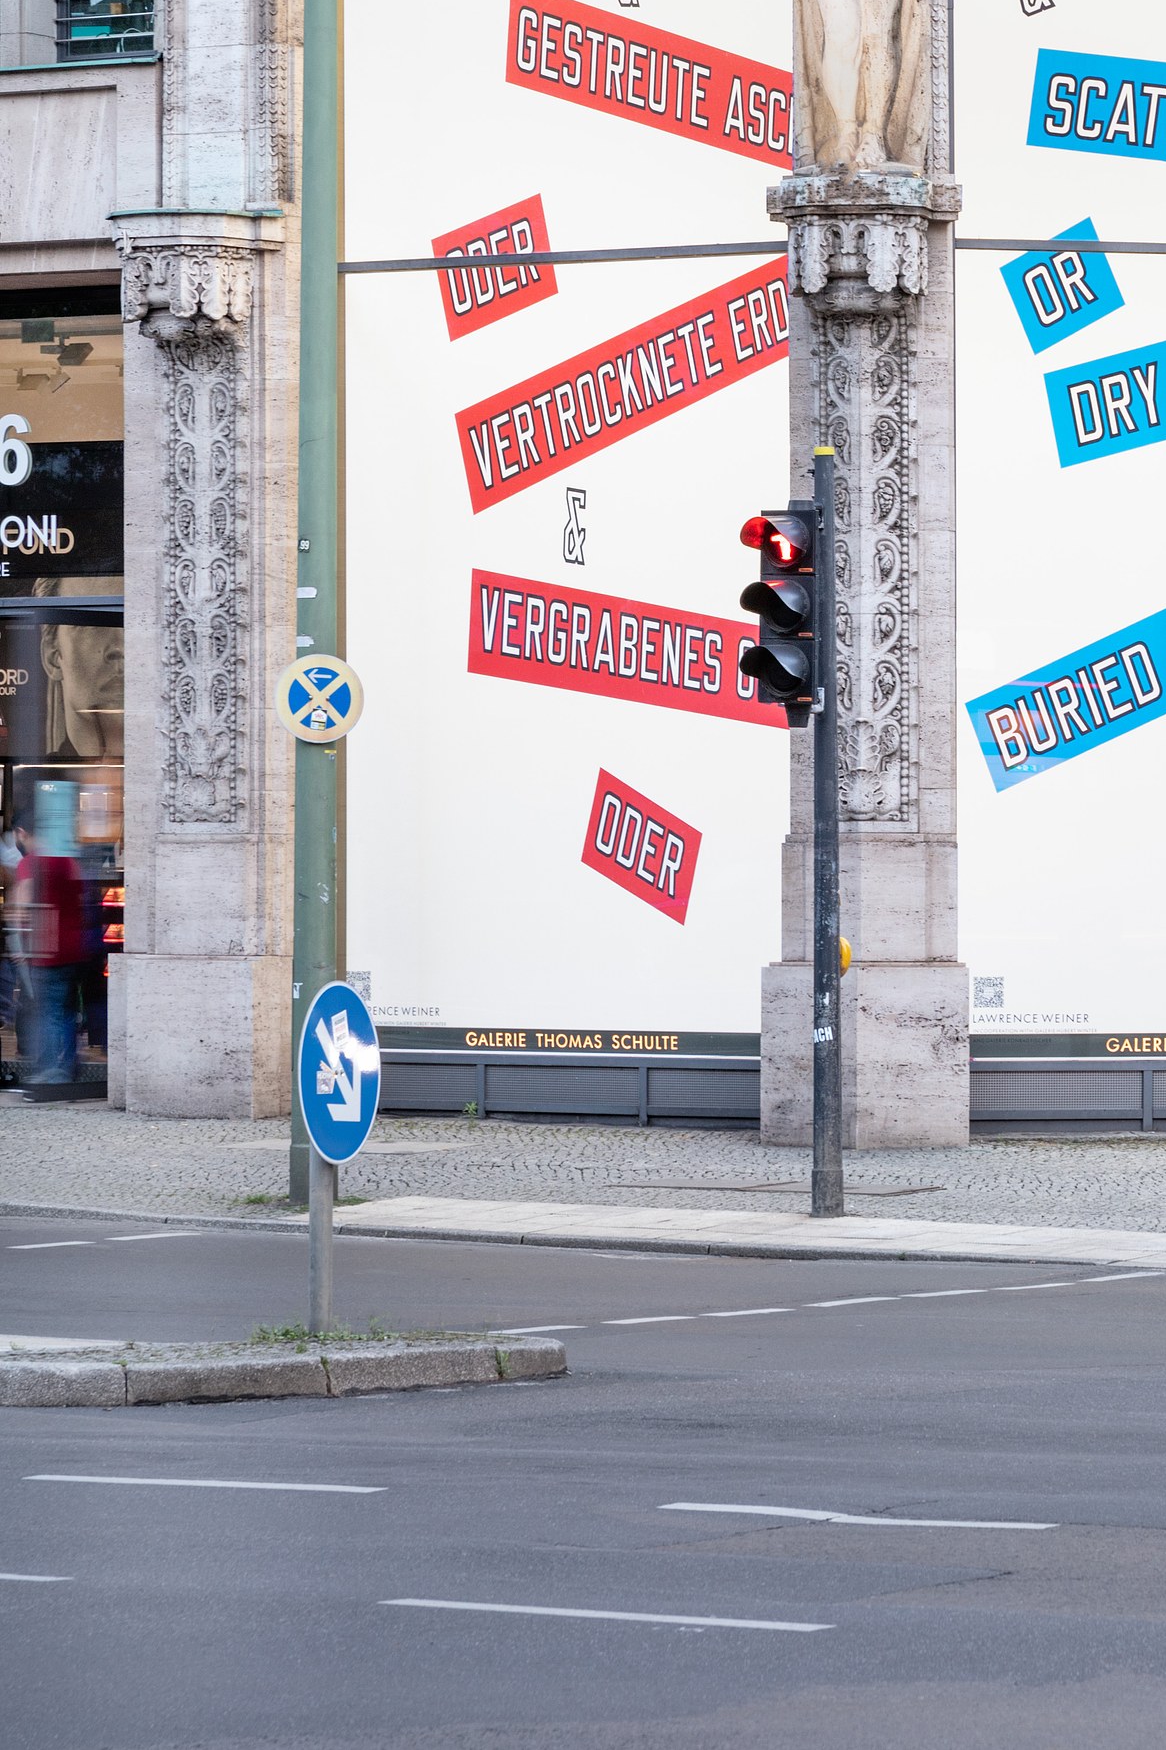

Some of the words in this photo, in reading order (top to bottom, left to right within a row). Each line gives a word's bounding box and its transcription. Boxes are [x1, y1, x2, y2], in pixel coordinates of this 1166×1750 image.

[516, 5, 711, 130] GESTREUTE
[445, 217, 541, 316] ODER
[1022, 249, 1099, 328] OR
[468, 310, 724, 491] VERTROCKNETE
[1067, 361, 1161, 447] DRY
[563, 487, 586, 566] &
[480, 584, 723, 696] VERGRABENES
[985, 640, 1163, 772] BURIED
[594, 790, 685, 900] ODER
[401, 1007, 440, 1017] WEINER
[465, 1031, 526, 1048] GALERIE
[535, 1033, 602, 1049] THOMAS
[611, 1035, 679, 1051] SCHULTE
[972, 1013, 1038, 1024] LAWRENCE
[1041, 1013, 1089, 1024] WEINER
